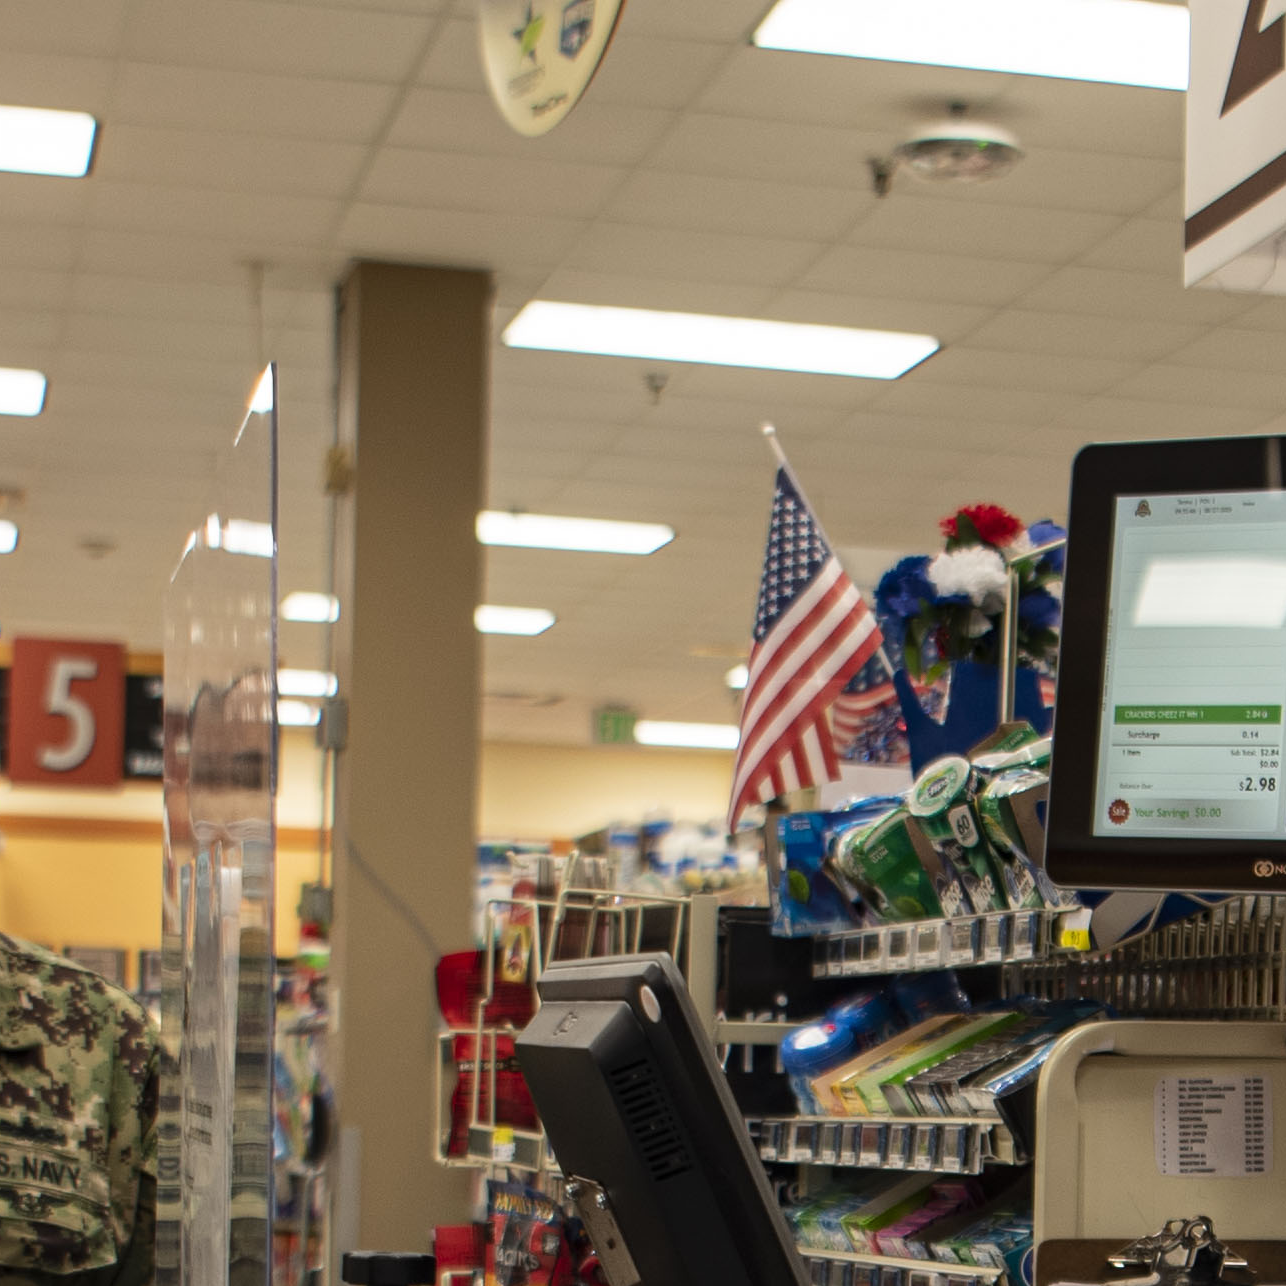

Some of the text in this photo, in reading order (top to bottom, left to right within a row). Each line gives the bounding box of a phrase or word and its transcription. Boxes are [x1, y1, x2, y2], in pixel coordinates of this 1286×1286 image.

[39, 656, 98, 773] 5
[1128, 730, 1259, 740] Surcharge 0.14
[1260, 760, 1279, 769] $0.00
[1239, 777, 1276, 793] $2.98
[1134, 807, 1154, 818] Your
[1156, 807, 1190, 820] Savings
[1195, 807, 1222, 818] $0.00
[21, 1155, 83, 1189] NAVY
